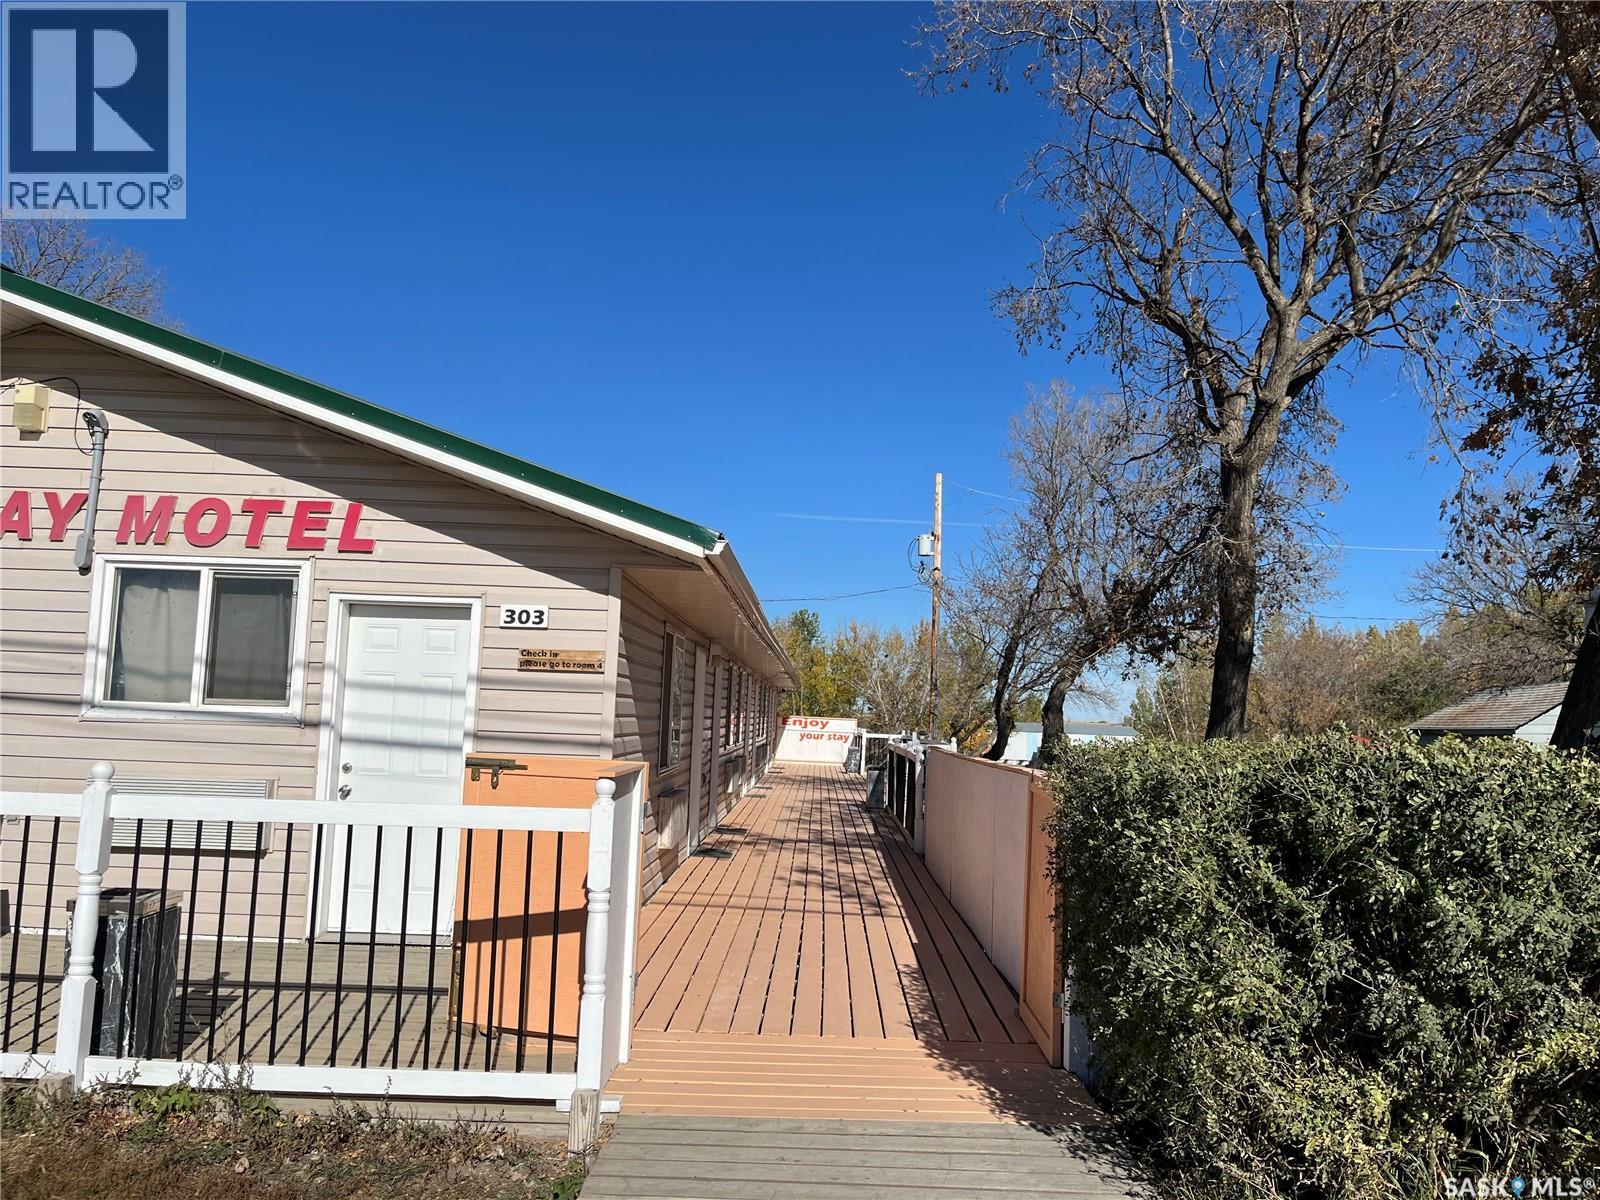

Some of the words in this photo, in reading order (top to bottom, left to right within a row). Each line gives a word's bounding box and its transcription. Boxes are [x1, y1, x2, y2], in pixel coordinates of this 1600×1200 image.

[115, 494, 376, 553] MOTEL
[503, 609, 545, 625] 303
[520, 649, 548, 658] Check
[519, 659, 547, 668] please
[549, 661, 560, 669] go
[573, 662, 596, 670] room
[782, 716, 829, 729] Enjoy
[799, 731, 824, 742] your
[827, 732, 850, 743] stay
